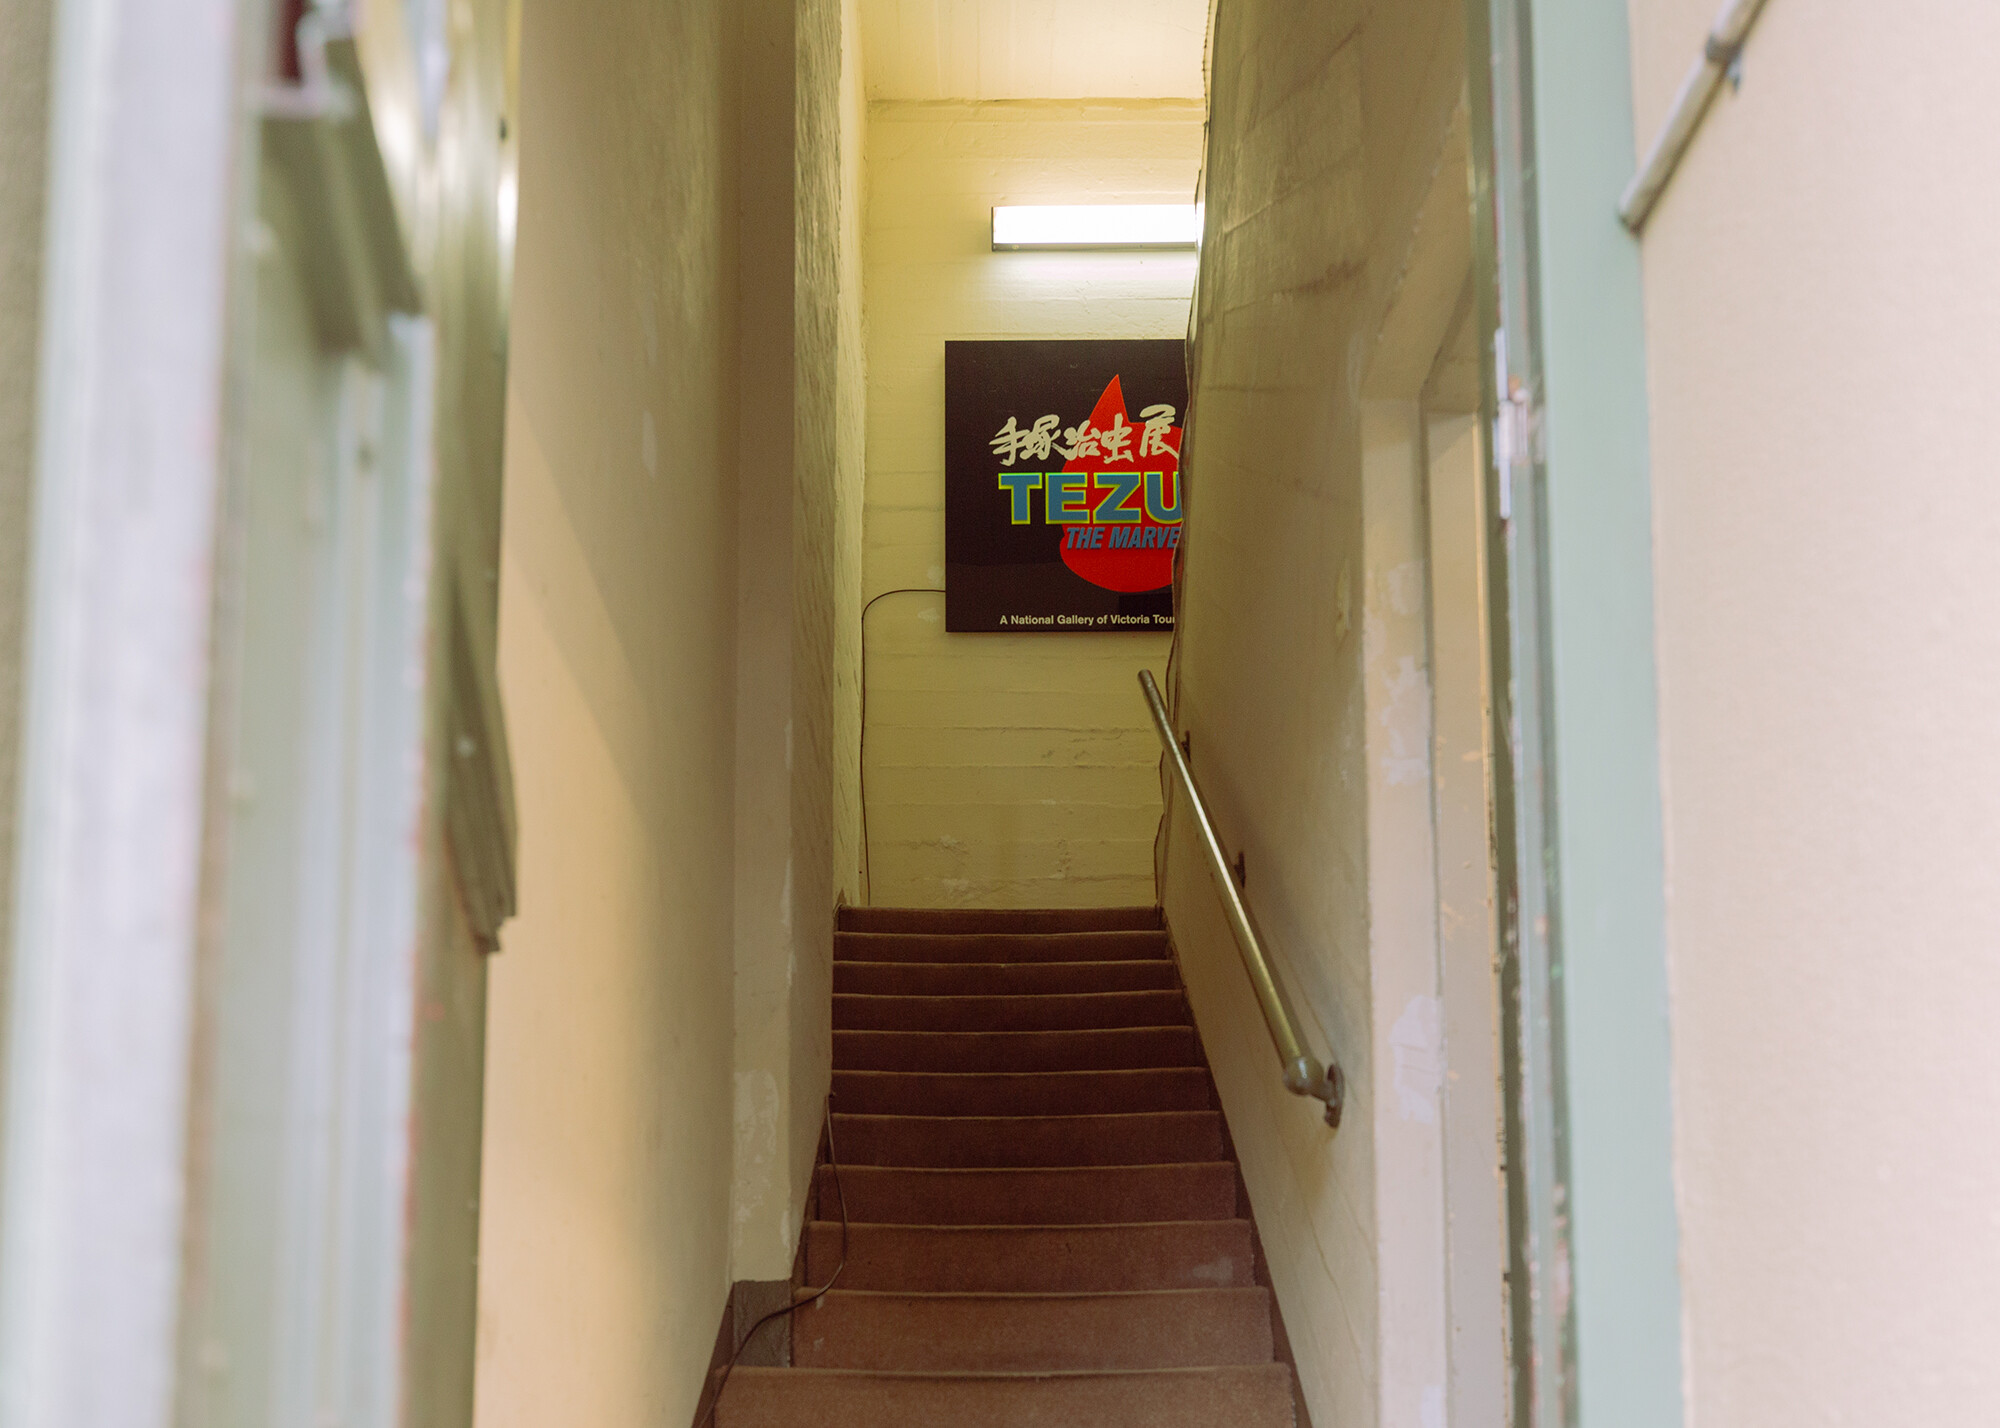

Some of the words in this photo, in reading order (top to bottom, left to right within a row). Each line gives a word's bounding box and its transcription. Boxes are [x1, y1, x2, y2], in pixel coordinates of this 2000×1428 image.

[998, 471, 1183, 525] TEZU
[1066, 527, 1105, 549] THE
[1109, 526, 1180, 549] MARVE
[1000, 615, 1008, 625] A
[1011, 614, 1054, 625] National
[1057, 614, 1094, 626] Gallery
[1096, 614, 1108, 625] of
[1110, 614, 1150, 625] Victoria
